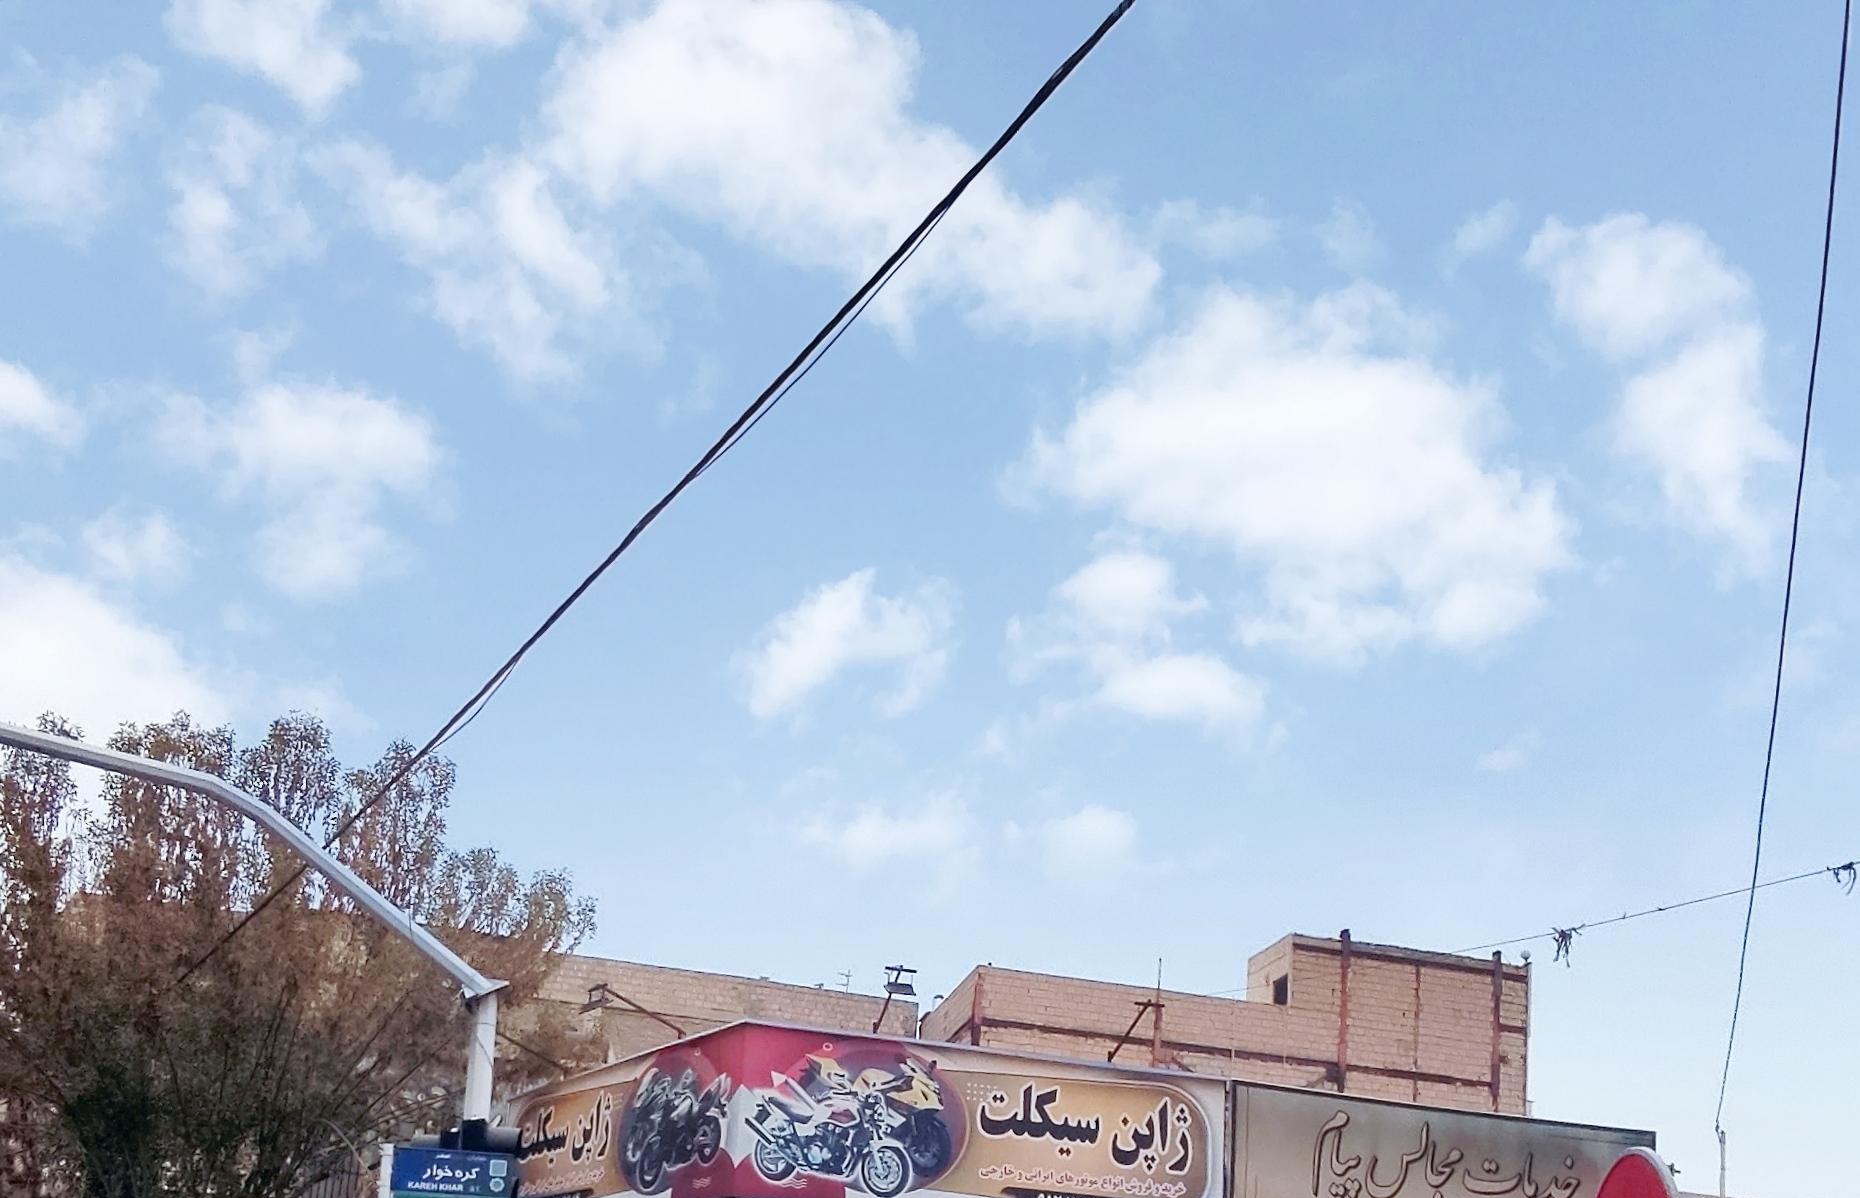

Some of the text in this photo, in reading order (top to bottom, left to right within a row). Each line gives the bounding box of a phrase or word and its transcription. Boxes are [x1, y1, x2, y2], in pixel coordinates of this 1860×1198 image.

[571, 1090, 612, 1164] ژاپن
[978, 1083, 1192, 1173] ژاپن سیکلت
[422, 1164, 480, 1182] کره خوار
[980, 1165, 1015, 1179] خارجی
[1025, 1170, 1054, 1182] ایرانی
[408, 1181, 437, 1191] KAREH
[439, 1183, 463, 1192] KHAR
[1100, 1178, 1124, 1190] انواع
[1125, 1179, 1152, 1194] فروش
[1160, 1182, 1185, 1197] خرید
